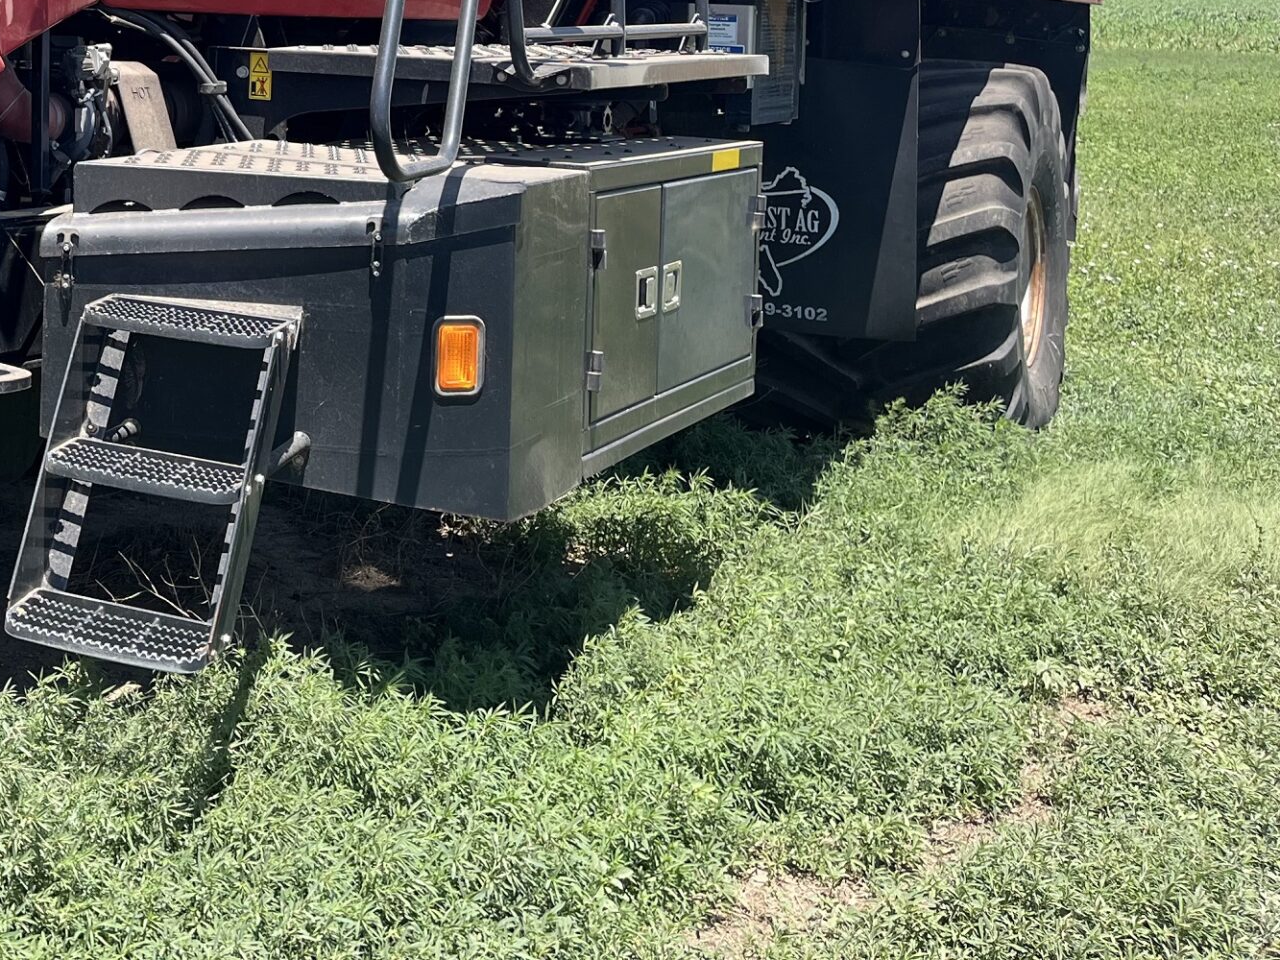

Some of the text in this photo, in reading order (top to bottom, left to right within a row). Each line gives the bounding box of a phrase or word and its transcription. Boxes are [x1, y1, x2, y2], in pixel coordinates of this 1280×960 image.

[130, 86, 153, 102] HOT
[763, 206, 820, 233] ST AG
[759, 228, 811, 245] nt Inc.
[764, 302, 828, 322] 9-3102
